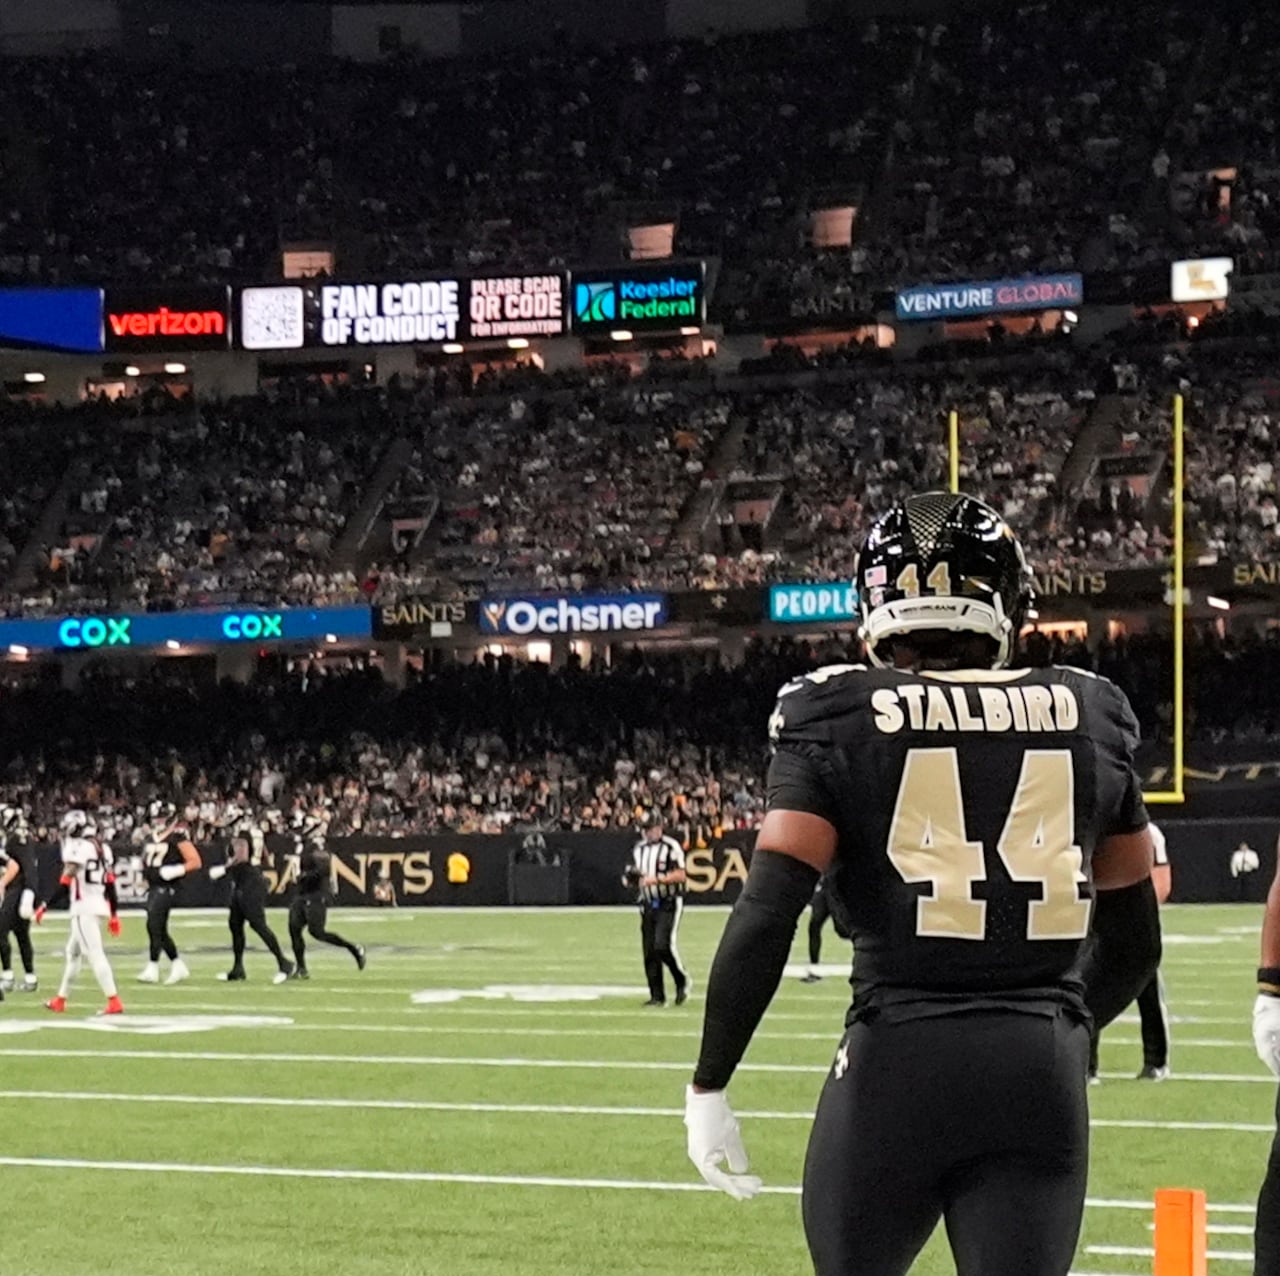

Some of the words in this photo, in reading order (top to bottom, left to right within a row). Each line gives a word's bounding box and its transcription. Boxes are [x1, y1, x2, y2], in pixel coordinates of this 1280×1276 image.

[322, 285, 377, 320] FAN
[382, 280, 459, 316] CODE
[470, 278, 521, 295] PLEASE
[524, 276, 561, 293] SCAN
[620, 277, 697, 299] Keesler
[899, 287, 993, 313] VENTURE
[995, 282, 1076, 305] GLOBAL
[109, 306, 225, 336] verizon
[470, 296, 501, 323] QR
[503, 293, 562, 320] CODE
[620, 296, 696, 319] Federal
[322, 317, 352, 345] OF
[354, 313, 459, 343] CONDUCT
[897, 561, 951, 599] 44
[1028, 571, 1107, 597] AINTS
[1233, 562, 1280, 585] SAI
[222, 614, 282, 639] COX
[381, 600, 467, 628] SAINTS
[505, 599, 662, 635] Ochsner
[58, 617, 131, 647] COX
[869, 683, 1080, 735] STALBIRD
[886, 746, 1094, 941] 44
